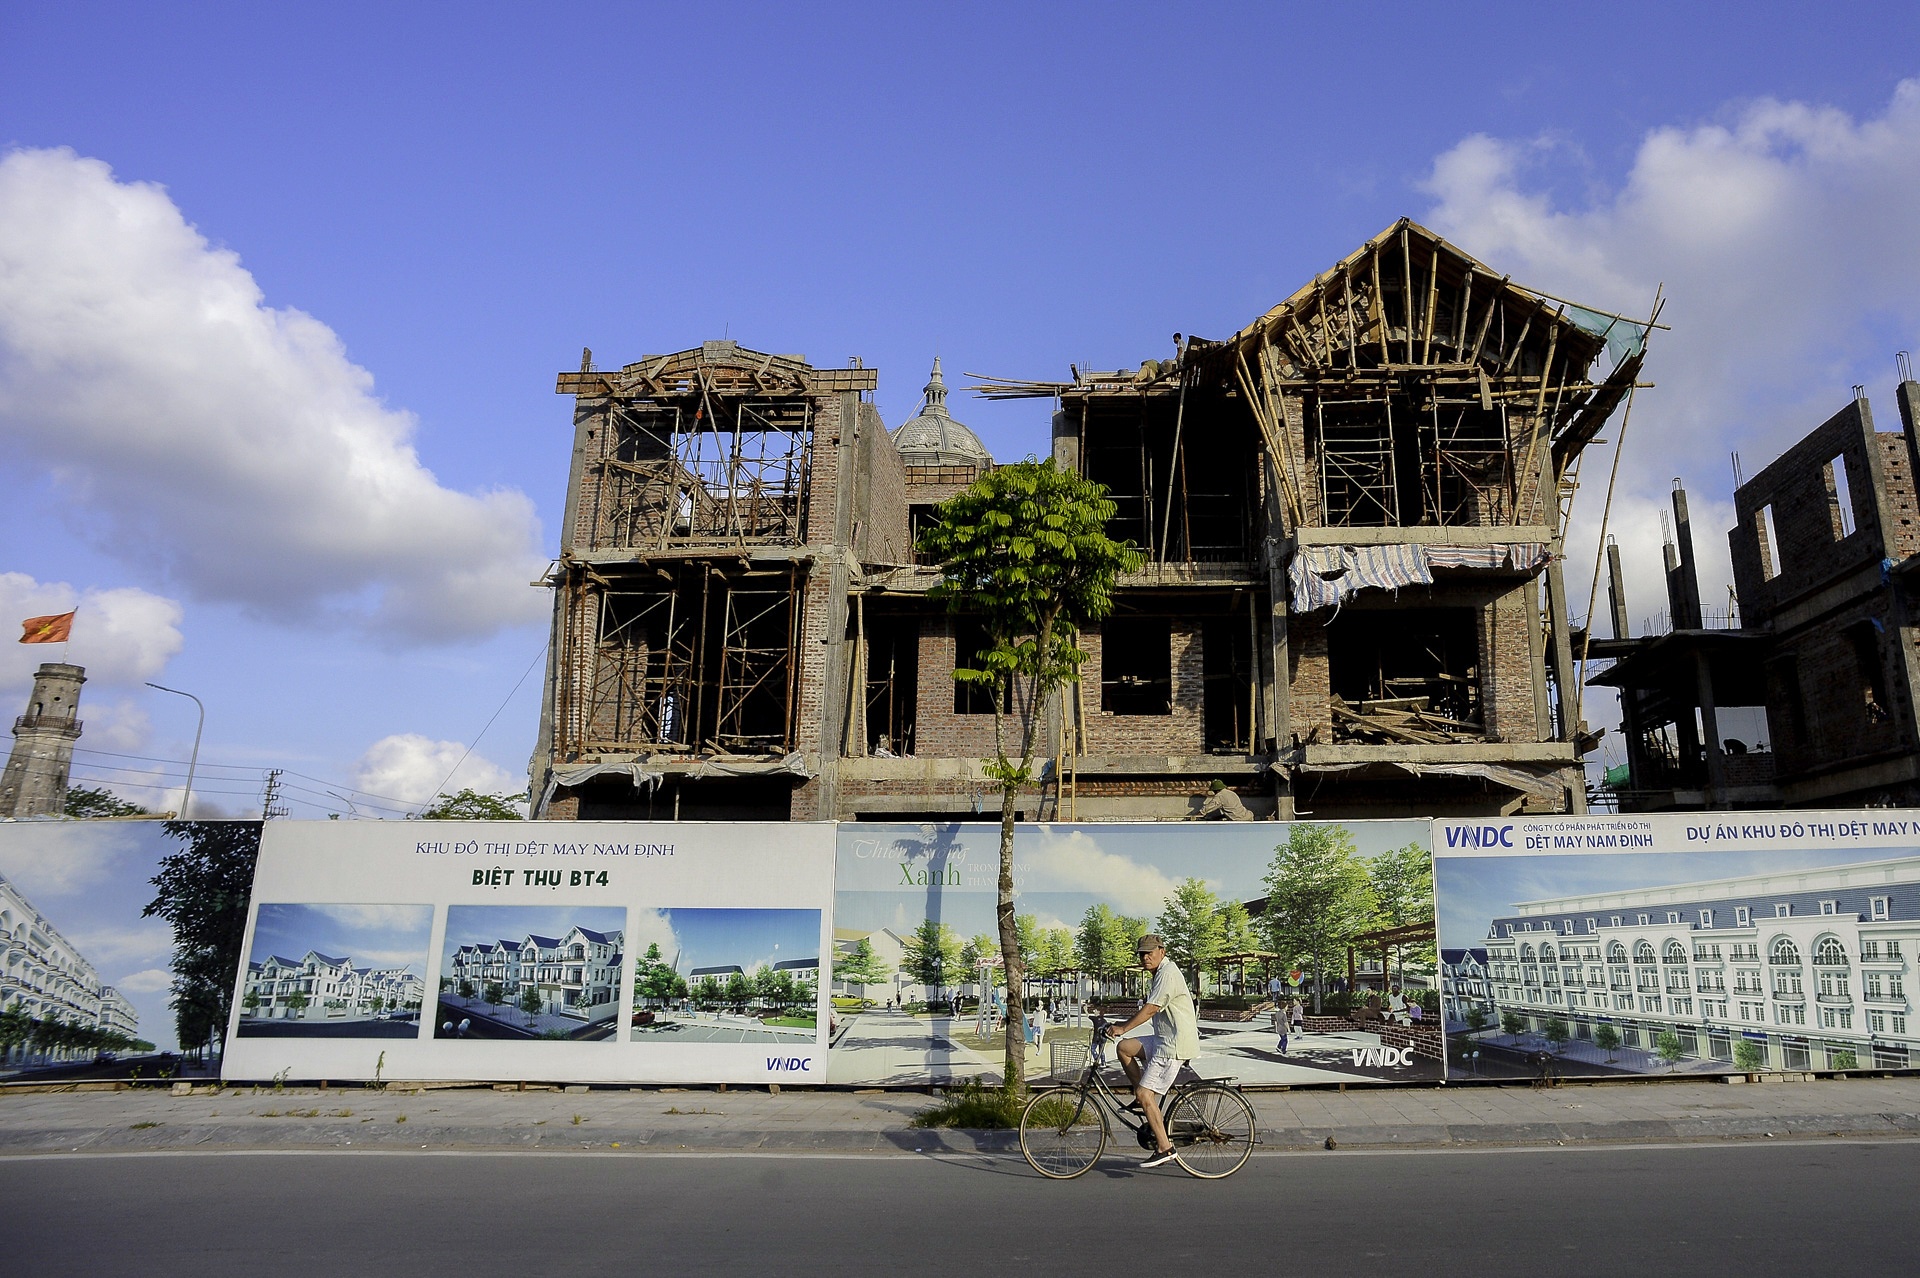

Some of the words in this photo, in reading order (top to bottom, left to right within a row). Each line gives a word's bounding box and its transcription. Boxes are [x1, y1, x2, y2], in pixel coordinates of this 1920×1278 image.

[1639, 822, 1651, 831] THỊ
[1686, 824, 1711, 843] DỰ
[1715, 824, 1738, 839] ÁN
[1742, 825, 1775, 838] KHU
[1780, 822, 1804, 838] ĐÔ
[1807, 823, 1835, 840] THỊ
[1838, 820, 1868, 840] DỆT
[1873, 822, 1907, 836] MAY
[1445, 825, 1514, 850] VNDC
[1525, 834, 1550, 851] DỆT
[1554, 836, 1582, 848] MAY
[1586, 835, 1617, 847] NAM
[1620, 834, 1653, 850] ĐỊNH
[416, 842, 450, 855] KHU
[454, 840, 479, 854] ĐÔ
[484, 843, 510, 857] THỊ
[515, 841, 549, 857] DỆT
[552, 843, 589, 855] MAY
[593, 844, 630, 855] NAM
[634, 844, 675, 858] ĐỊNH
[472, 866, 515, 890] BIỆT
[523, 869, 563, 890] THỰ
[570, 870, 609, 887] BT4
[898, 862, 961, 886] Xanh
[766, 1057, 812, 1072] VNDC
[1352, 1048, 1414, 1067] VNDC
